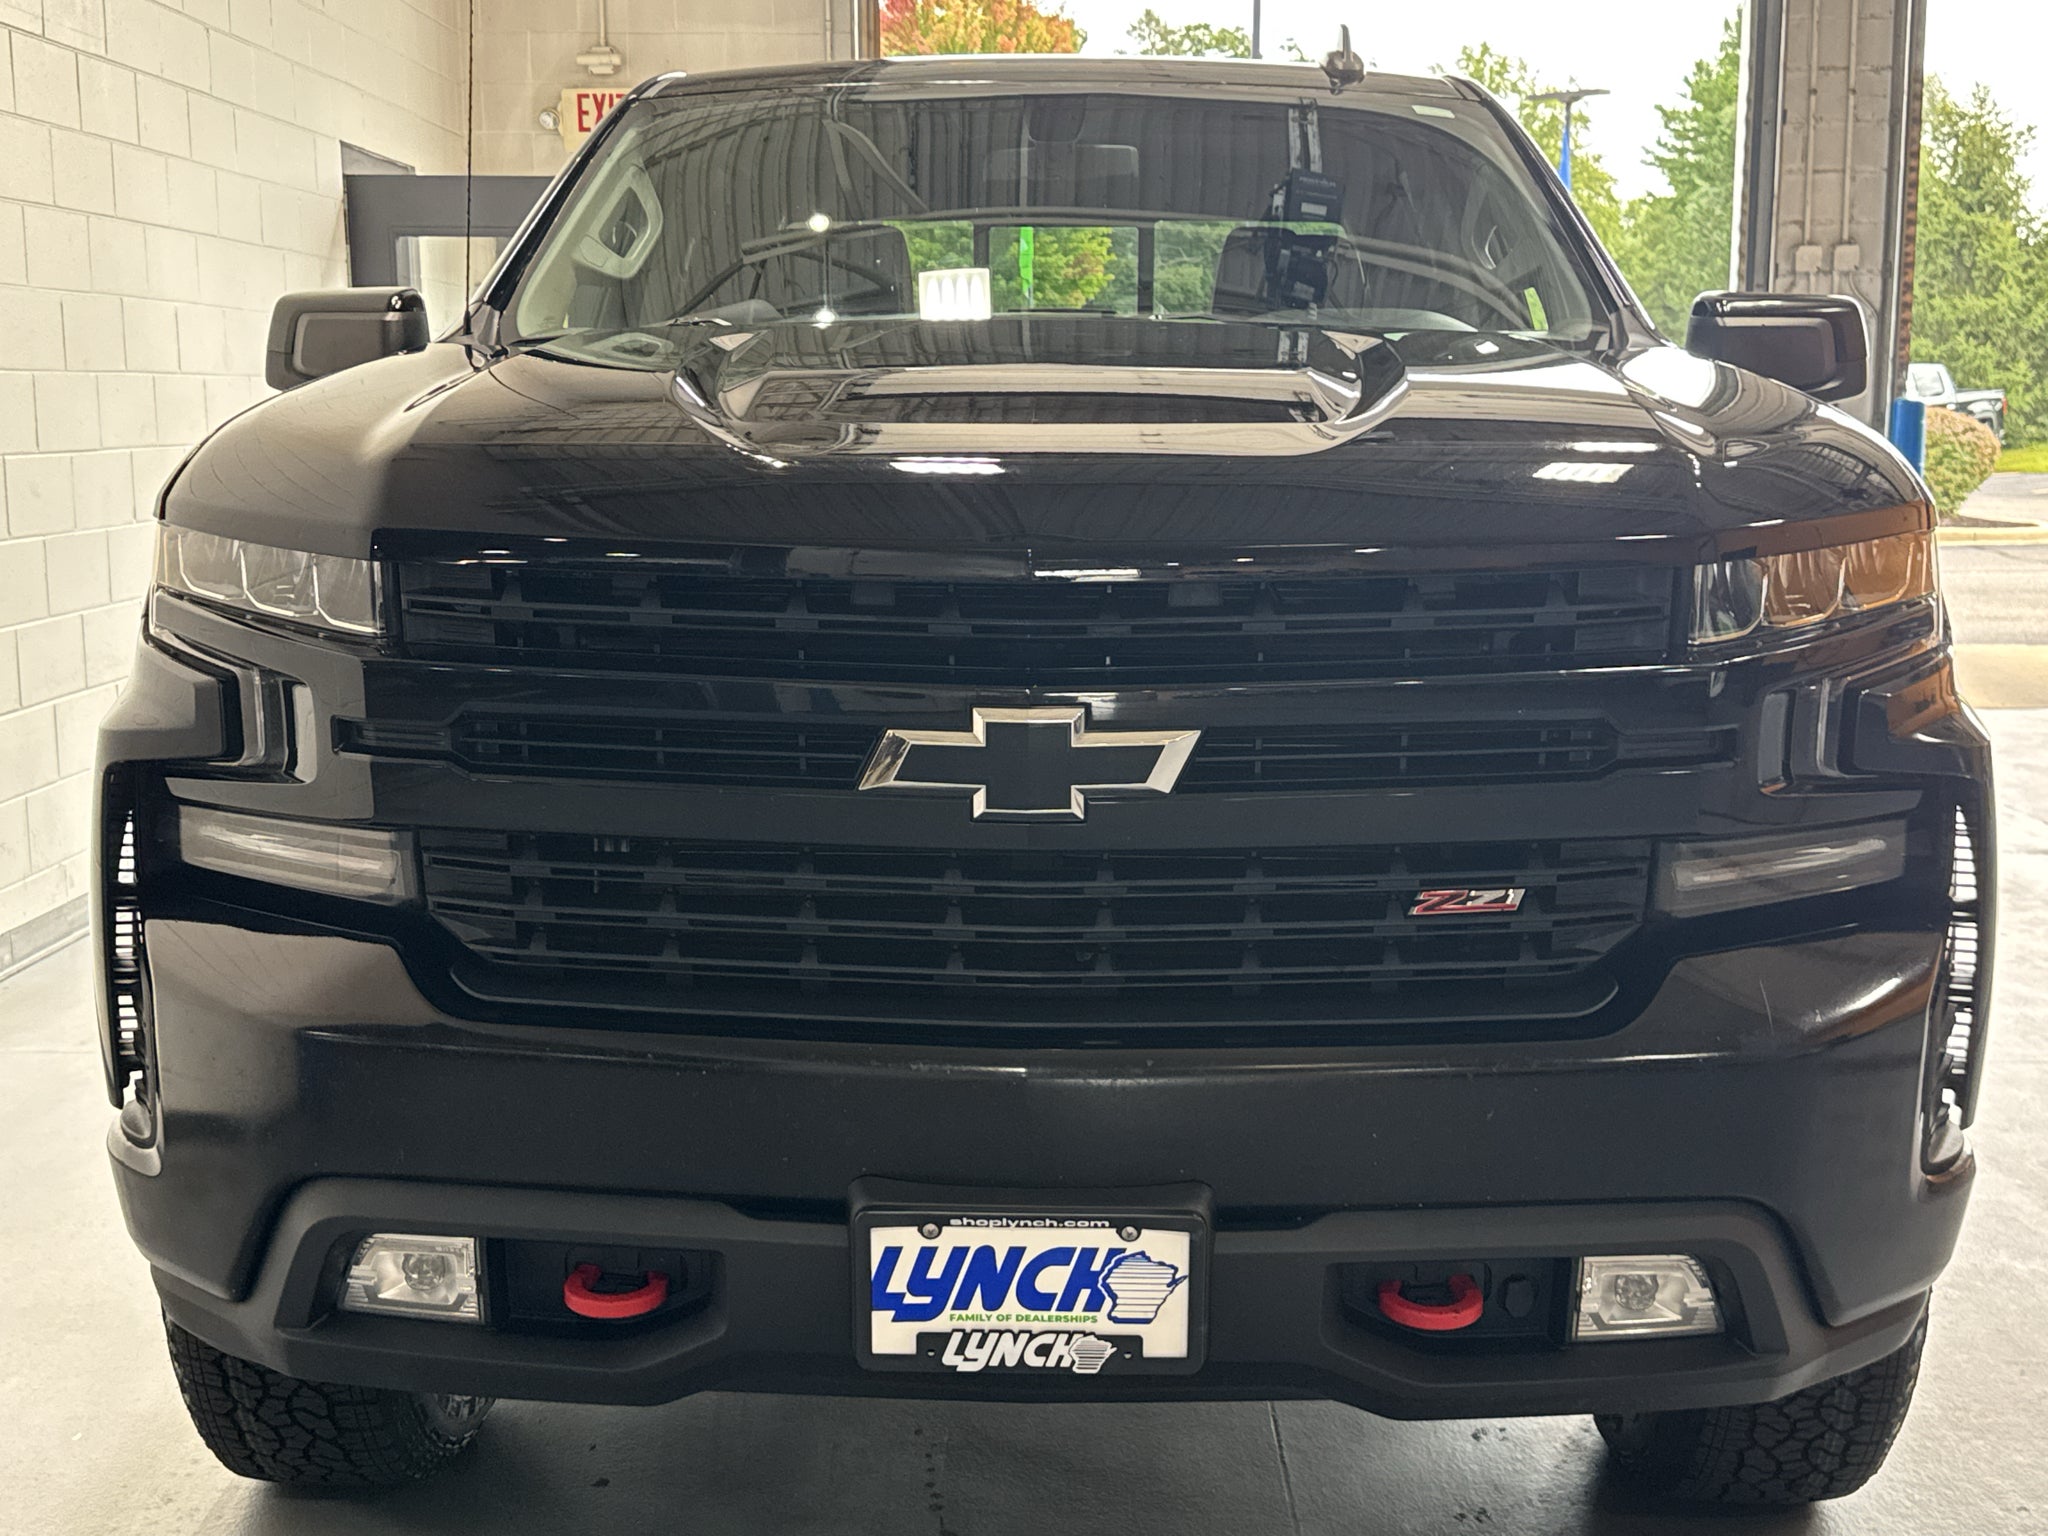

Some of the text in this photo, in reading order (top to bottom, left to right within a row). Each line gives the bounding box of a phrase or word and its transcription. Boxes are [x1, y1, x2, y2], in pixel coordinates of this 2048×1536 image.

[576, 93, 626, 133] EX
[949, 1217, 1110, 1229] shoplynch.com
[871, 1244, 1127, 1322] LYNCH
[949, 1313, 1098, 1324] FAMILY OF DEALERSHIPS
[941, 1330, 1085, 1373] LYNCH
